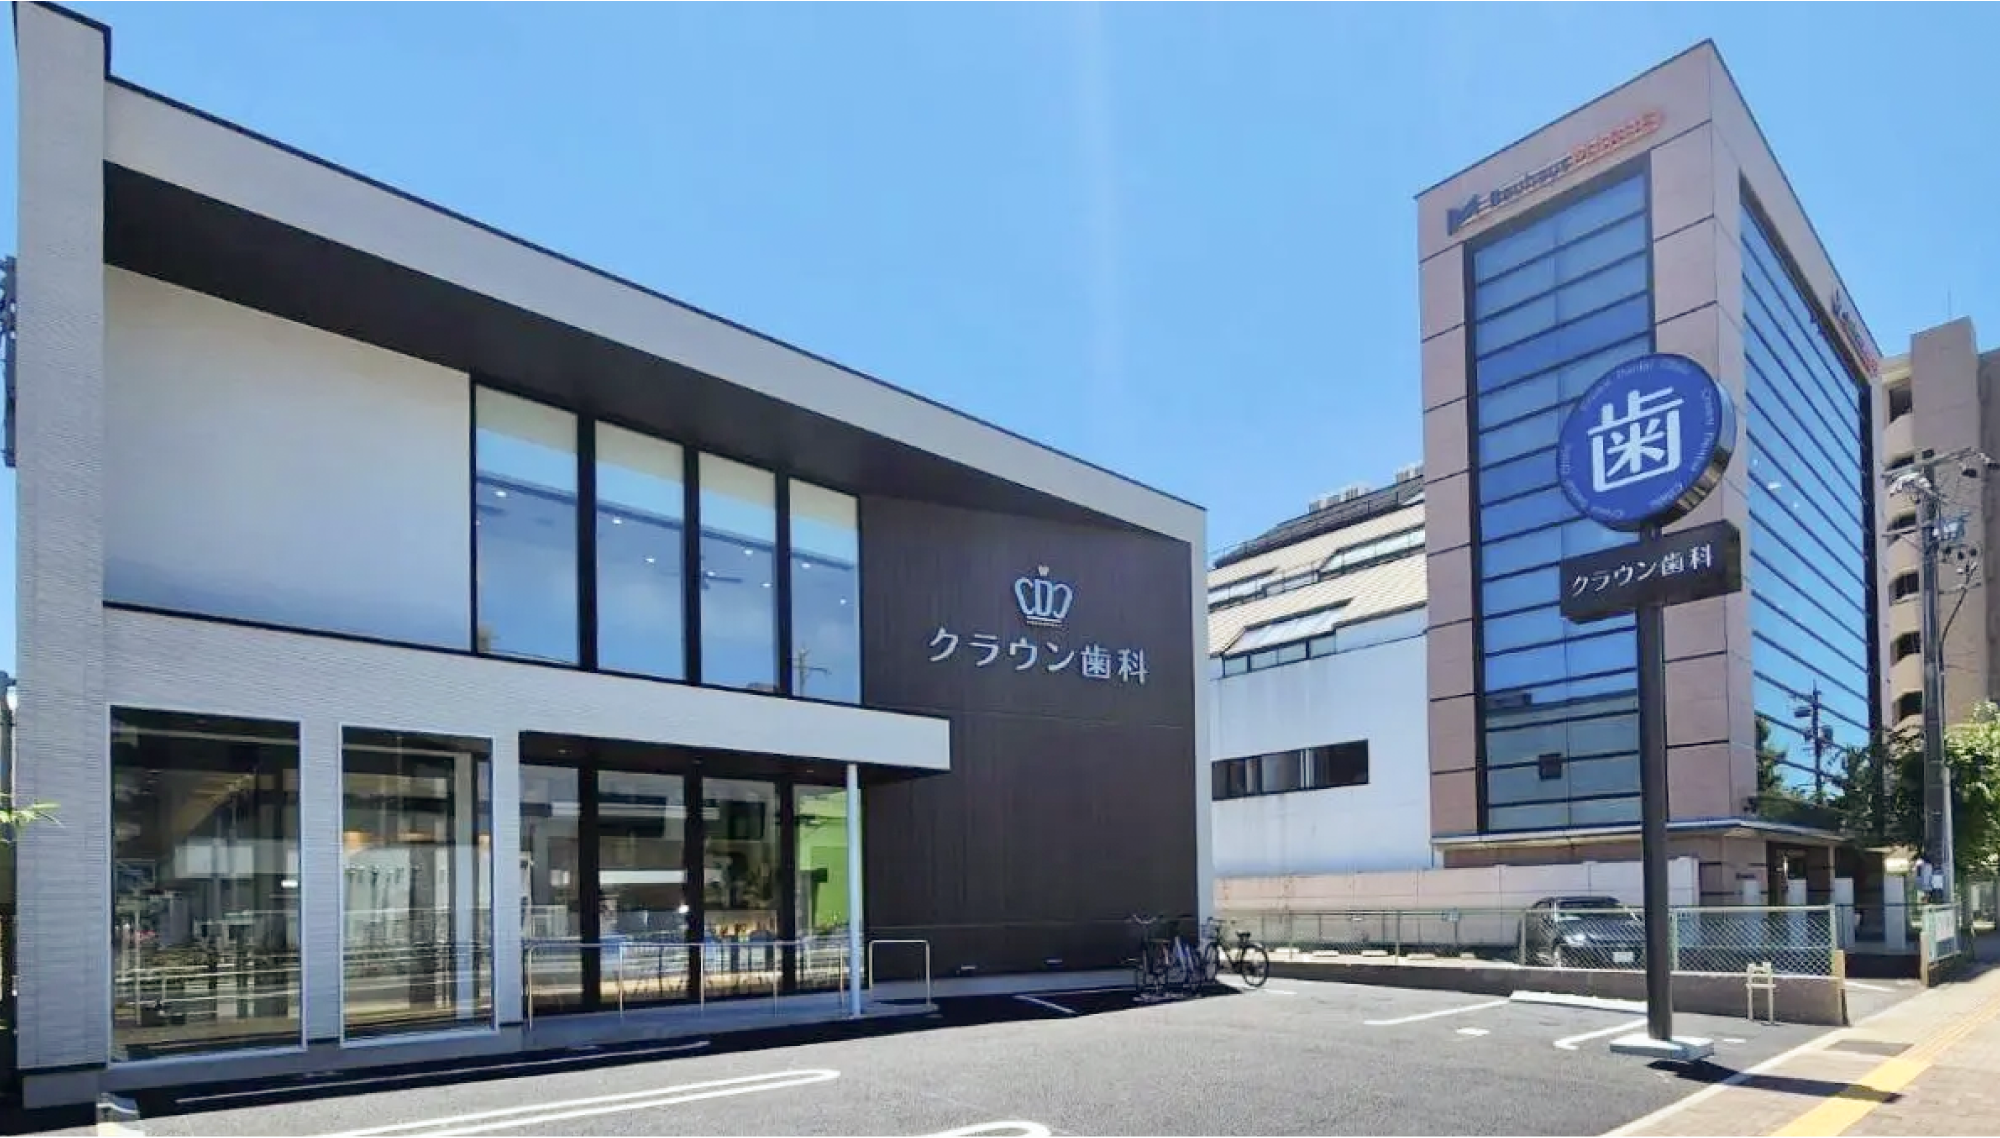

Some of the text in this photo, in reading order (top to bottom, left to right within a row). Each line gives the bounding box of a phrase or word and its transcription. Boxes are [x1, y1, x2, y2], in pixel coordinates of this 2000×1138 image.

[1587, 385, 1684, 493] 歯
[1571, 543, 1713, 597] クラウン歯科
[929, 627, 1149, 685] クラウン歯科
